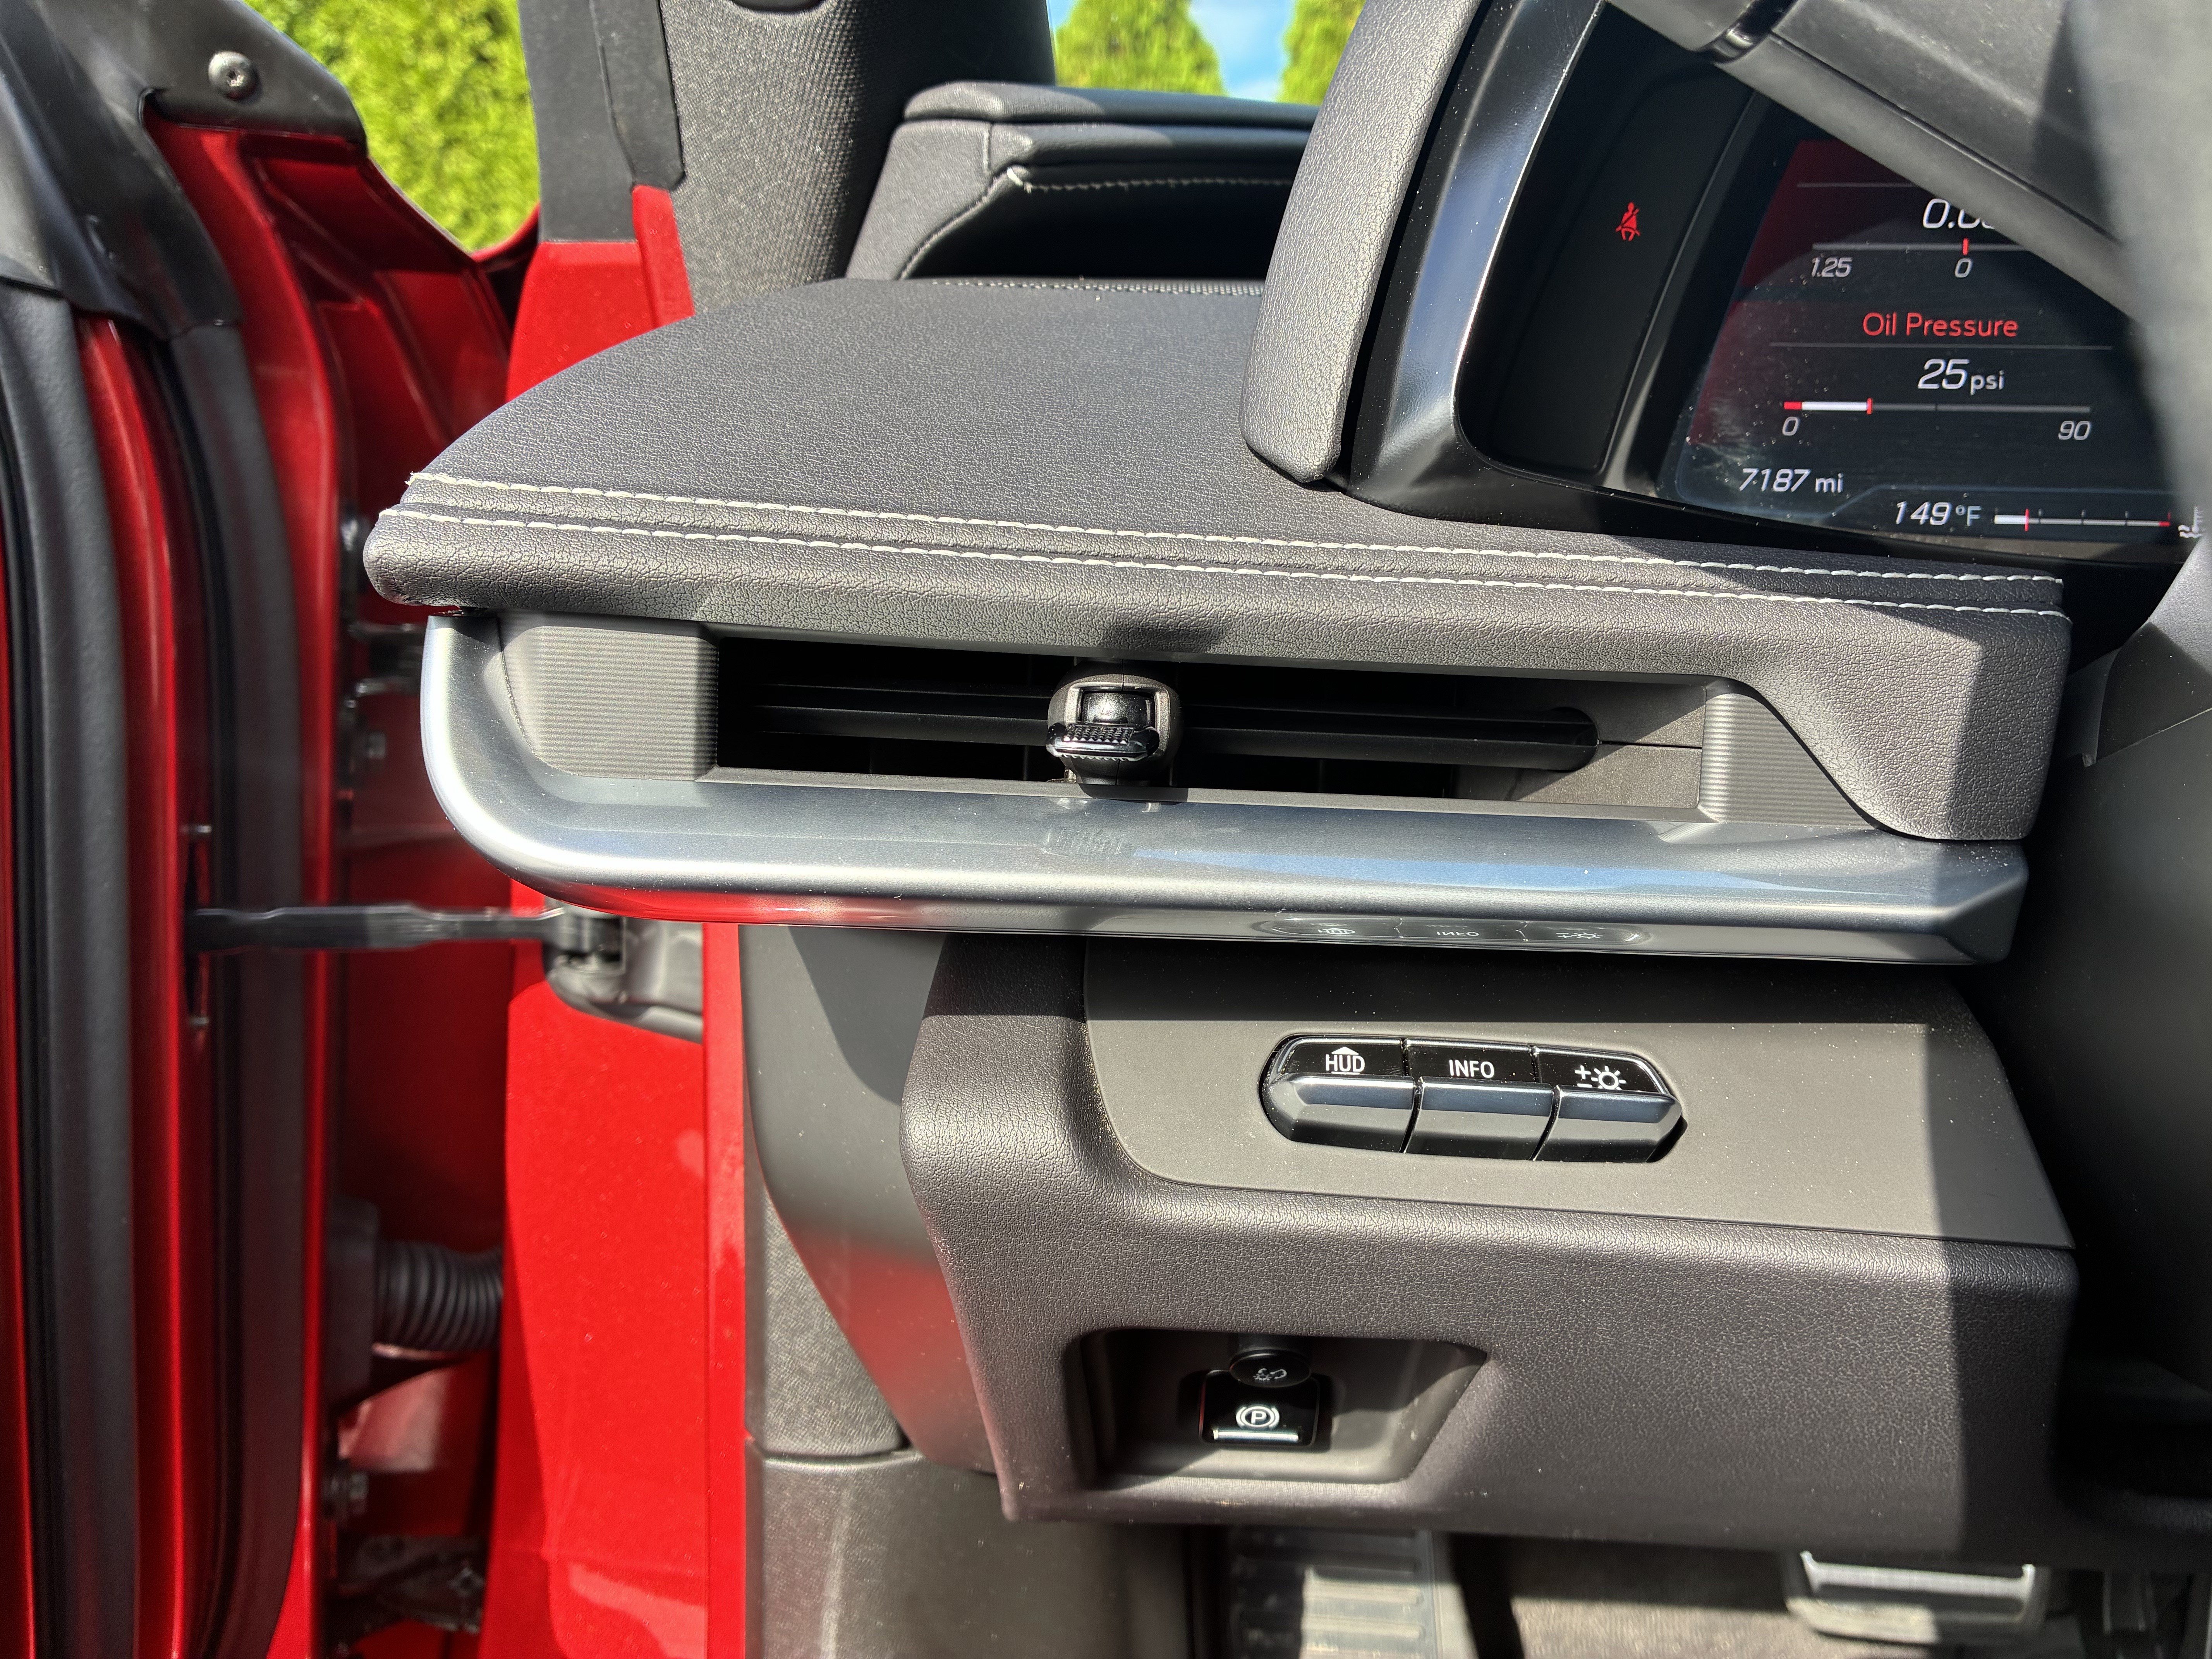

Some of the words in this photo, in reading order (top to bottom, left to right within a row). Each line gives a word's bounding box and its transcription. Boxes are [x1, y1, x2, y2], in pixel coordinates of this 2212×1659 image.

[1923, 198, 1995, 229] 0.0
[1811, 257, 1853, 277] 1.25
[1955, 258, 1973, 278] 0
[1863, 311, 1897, 336] Oil
[1906, 312, 2018, 337] Pressure
[1918, 359, 1970, 389] 25
[1970, 370, 2005, 396] psi
[1782, 416, 1799, 436] 0
[2058, 421, 2090, 440] 90
[1739, 468, 1812, 493] 7187
[1815, 473, 1844, 493] mi
[1896, 501, 1952, 526] 149
[1956, 504, 1982, 527] °F
[1325, 1054, 1365, 1072] HUD
[1449, 1059, 1494, 1079] INFO
